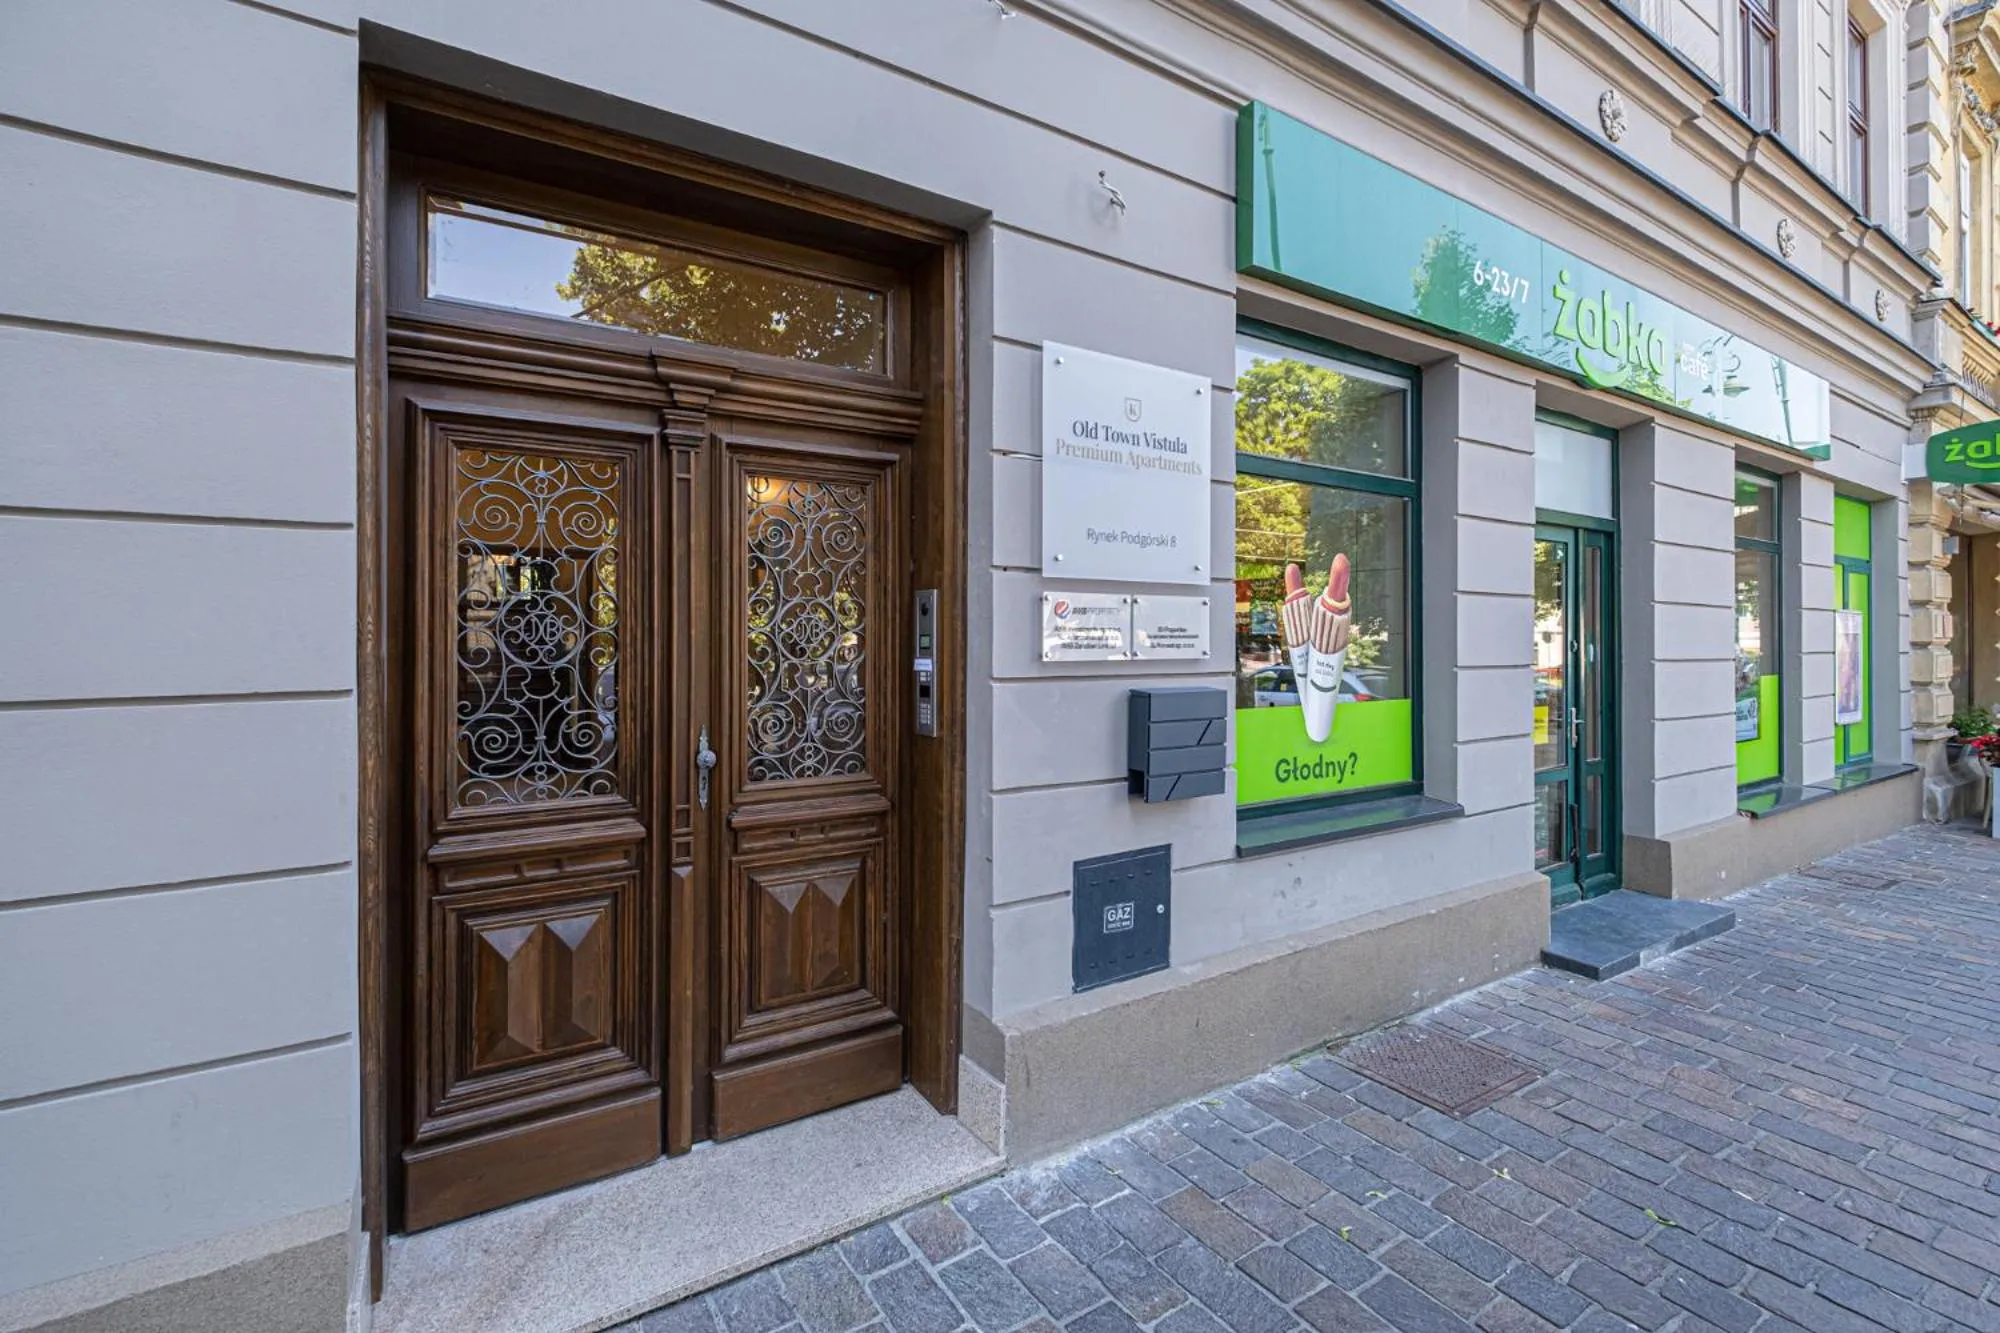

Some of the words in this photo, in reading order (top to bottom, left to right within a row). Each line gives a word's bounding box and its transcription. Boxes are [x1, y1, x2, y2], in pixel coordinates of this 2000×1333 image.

[1473, 260, 1530, 304] 6-23/7
[1553, 269, 1666, 376] żabka
[1072, 419, 1099, 440] Old
[1101, 425, 1140, 447] Town
[1143, 431, 1188, 454] Vistula
[1944, 432, 2000, 462] ża
[1056, 438, 1123, 465] Premium
[1126, 451, 1203, 475] Apartments
[1087, 527, 1119, 544] Rynek
[1120, 531, 1168, 549] Podgórski
[1169, 535, 1177, 548] 8
[1275, 752, 1358, 783] Głodny?
[1107, 906, 1131, 922] GAZ
